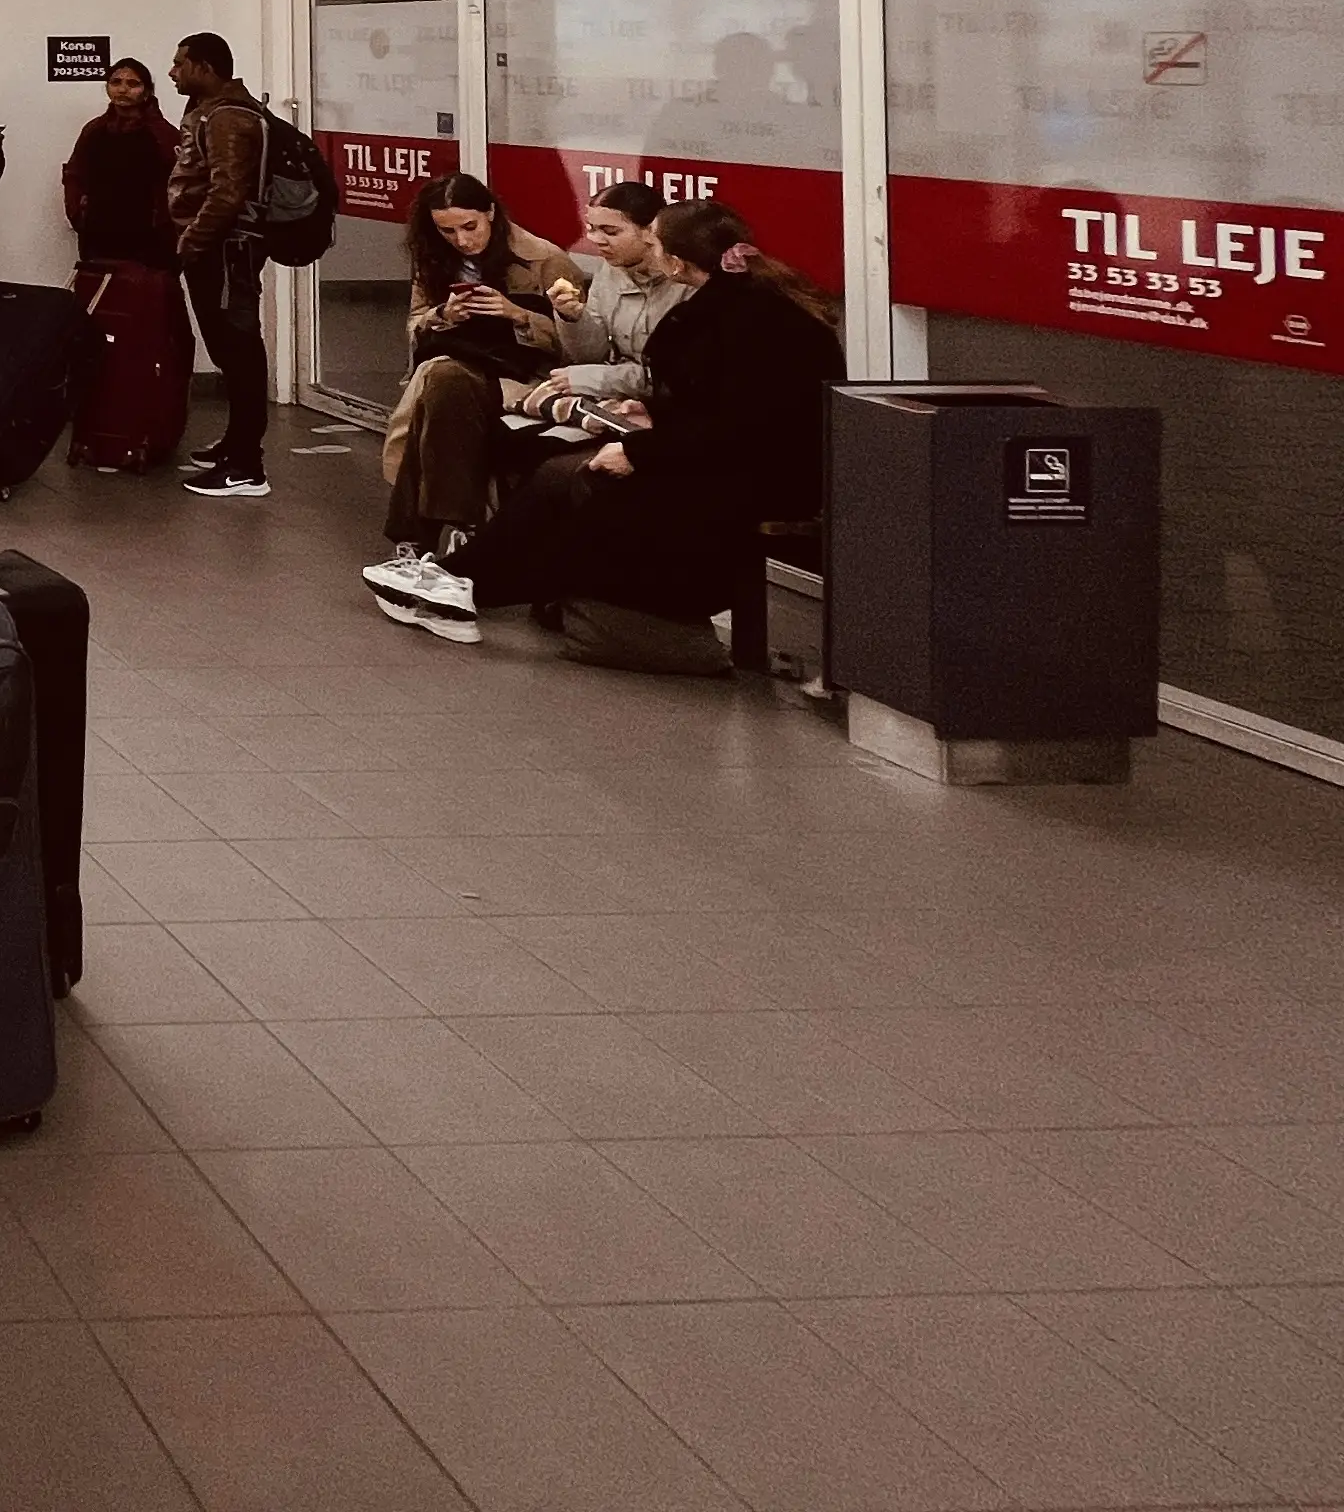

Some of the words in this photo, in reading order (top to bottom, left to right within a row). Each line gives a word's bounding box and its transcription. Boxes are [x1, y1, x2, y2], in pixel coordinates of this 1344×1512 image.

[343, 143, 377, 172] TIL
[383, 147, 431, 182] LEJE
[345, 174, 357, 186] 33
[358, 176, 371, 188] 53
[372, 178, 384, 190] 33
[386, 179, 399, 192] 53
[1061, 208, 1158, 261] TIL
[1181, 219, 1326, 285] LEJE
[1067, 262, 1099, 282] 33
[1106, 267, 1138, 287] 53
[1146, 271, 1180, 292] 33
[1188, 277, 1223, 298] 53
